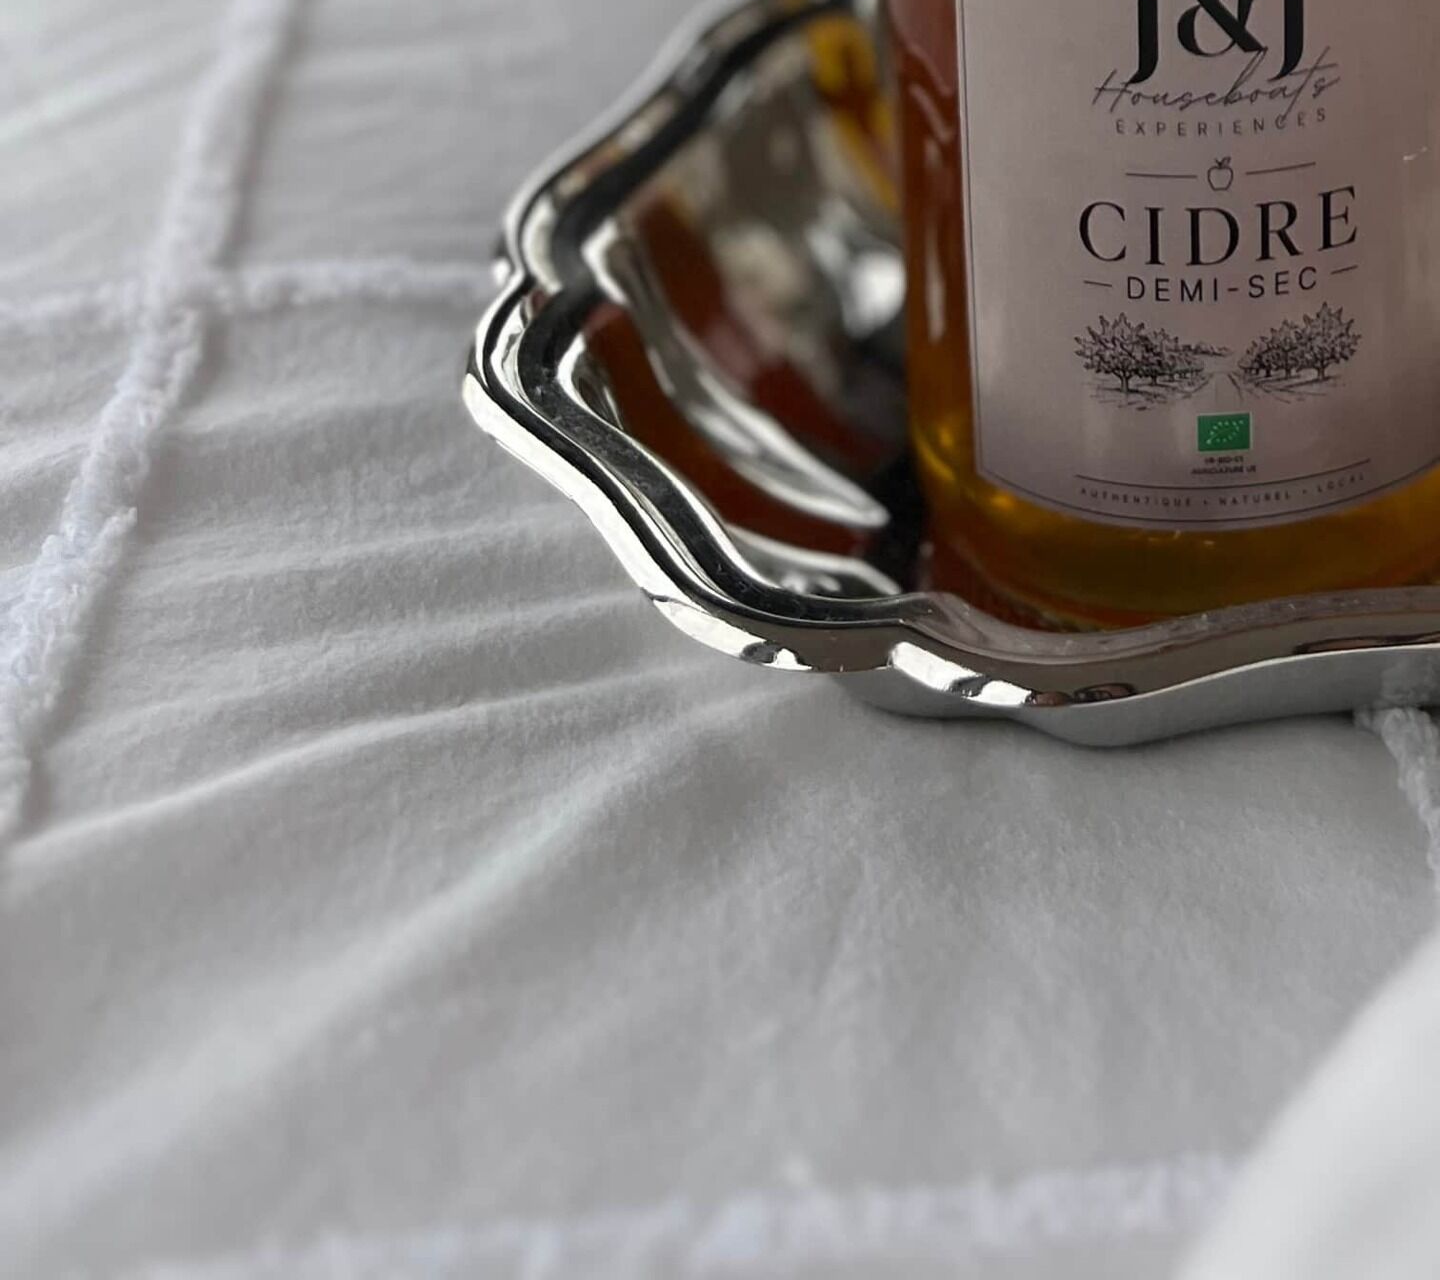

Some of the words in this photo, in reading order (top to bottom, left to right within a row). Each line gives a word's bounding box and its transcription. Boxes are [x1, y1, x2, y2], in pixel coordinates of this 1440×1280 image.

[1091, 45, 1341, 124] Houseboats
[1115, 107, 1328, 137] EXPERIENCES
[1078, 185, 1358, 267] CIDRE
[1126, 265, 1319, 302] DEMI-SEC
